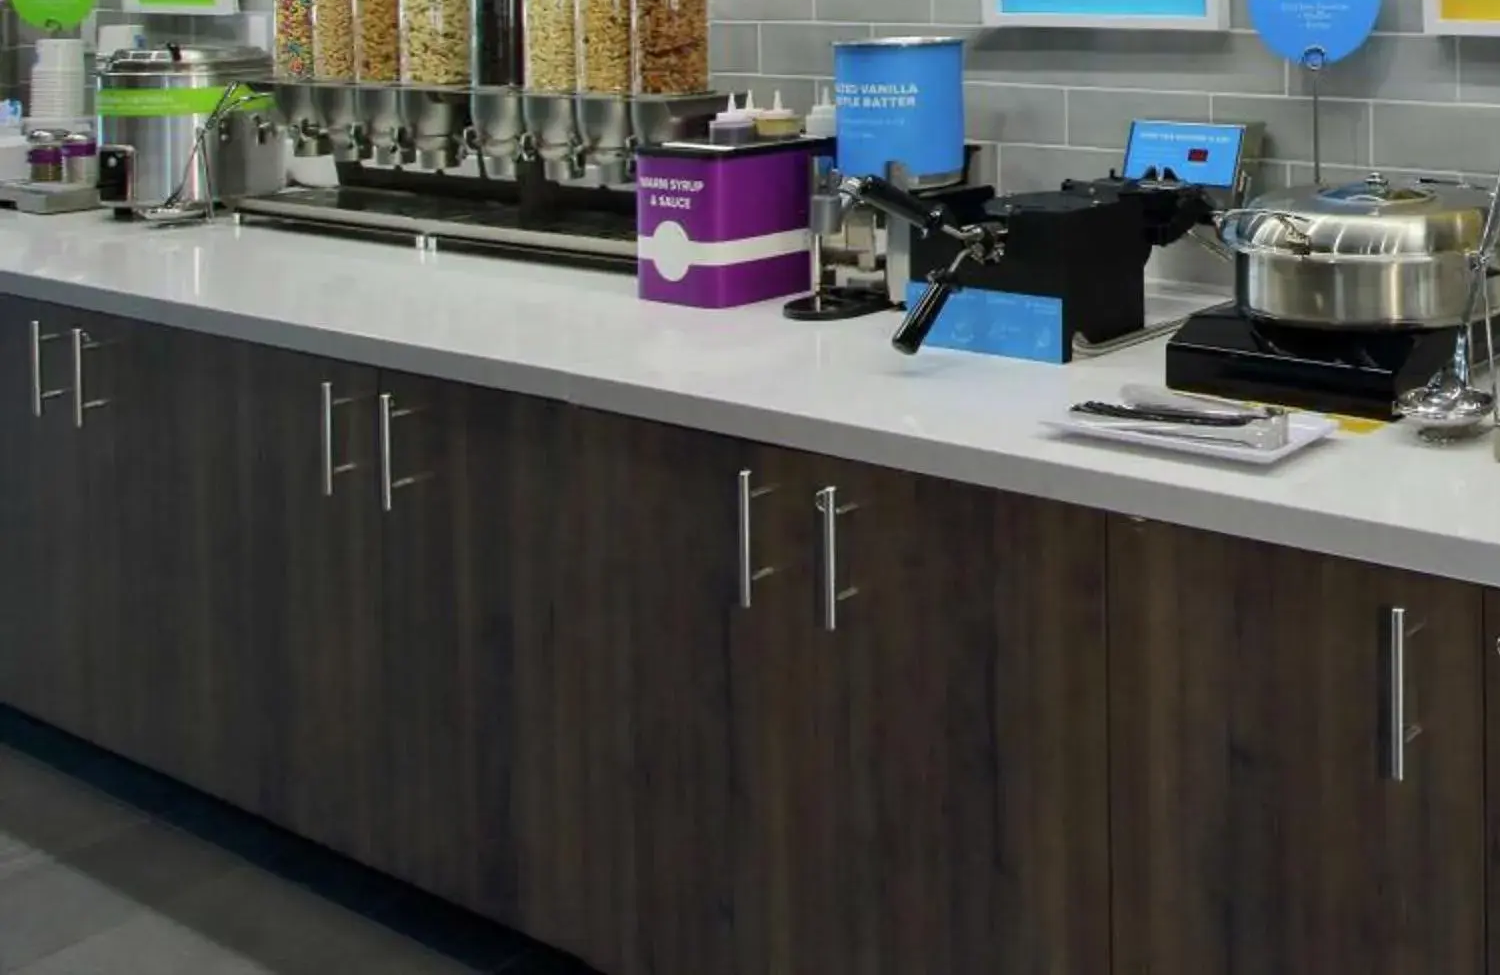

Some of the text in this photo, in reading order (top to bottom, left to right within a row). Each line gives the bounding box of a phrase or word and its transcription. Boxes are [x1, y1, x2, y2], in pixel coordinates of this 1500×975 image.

[861, 82, 919, 95] VANILLA
[862, 95, 917, 109] BATTER
[669, 178, 705, 193] SYRUP
[658, 195, 691, 209] SAUCE
